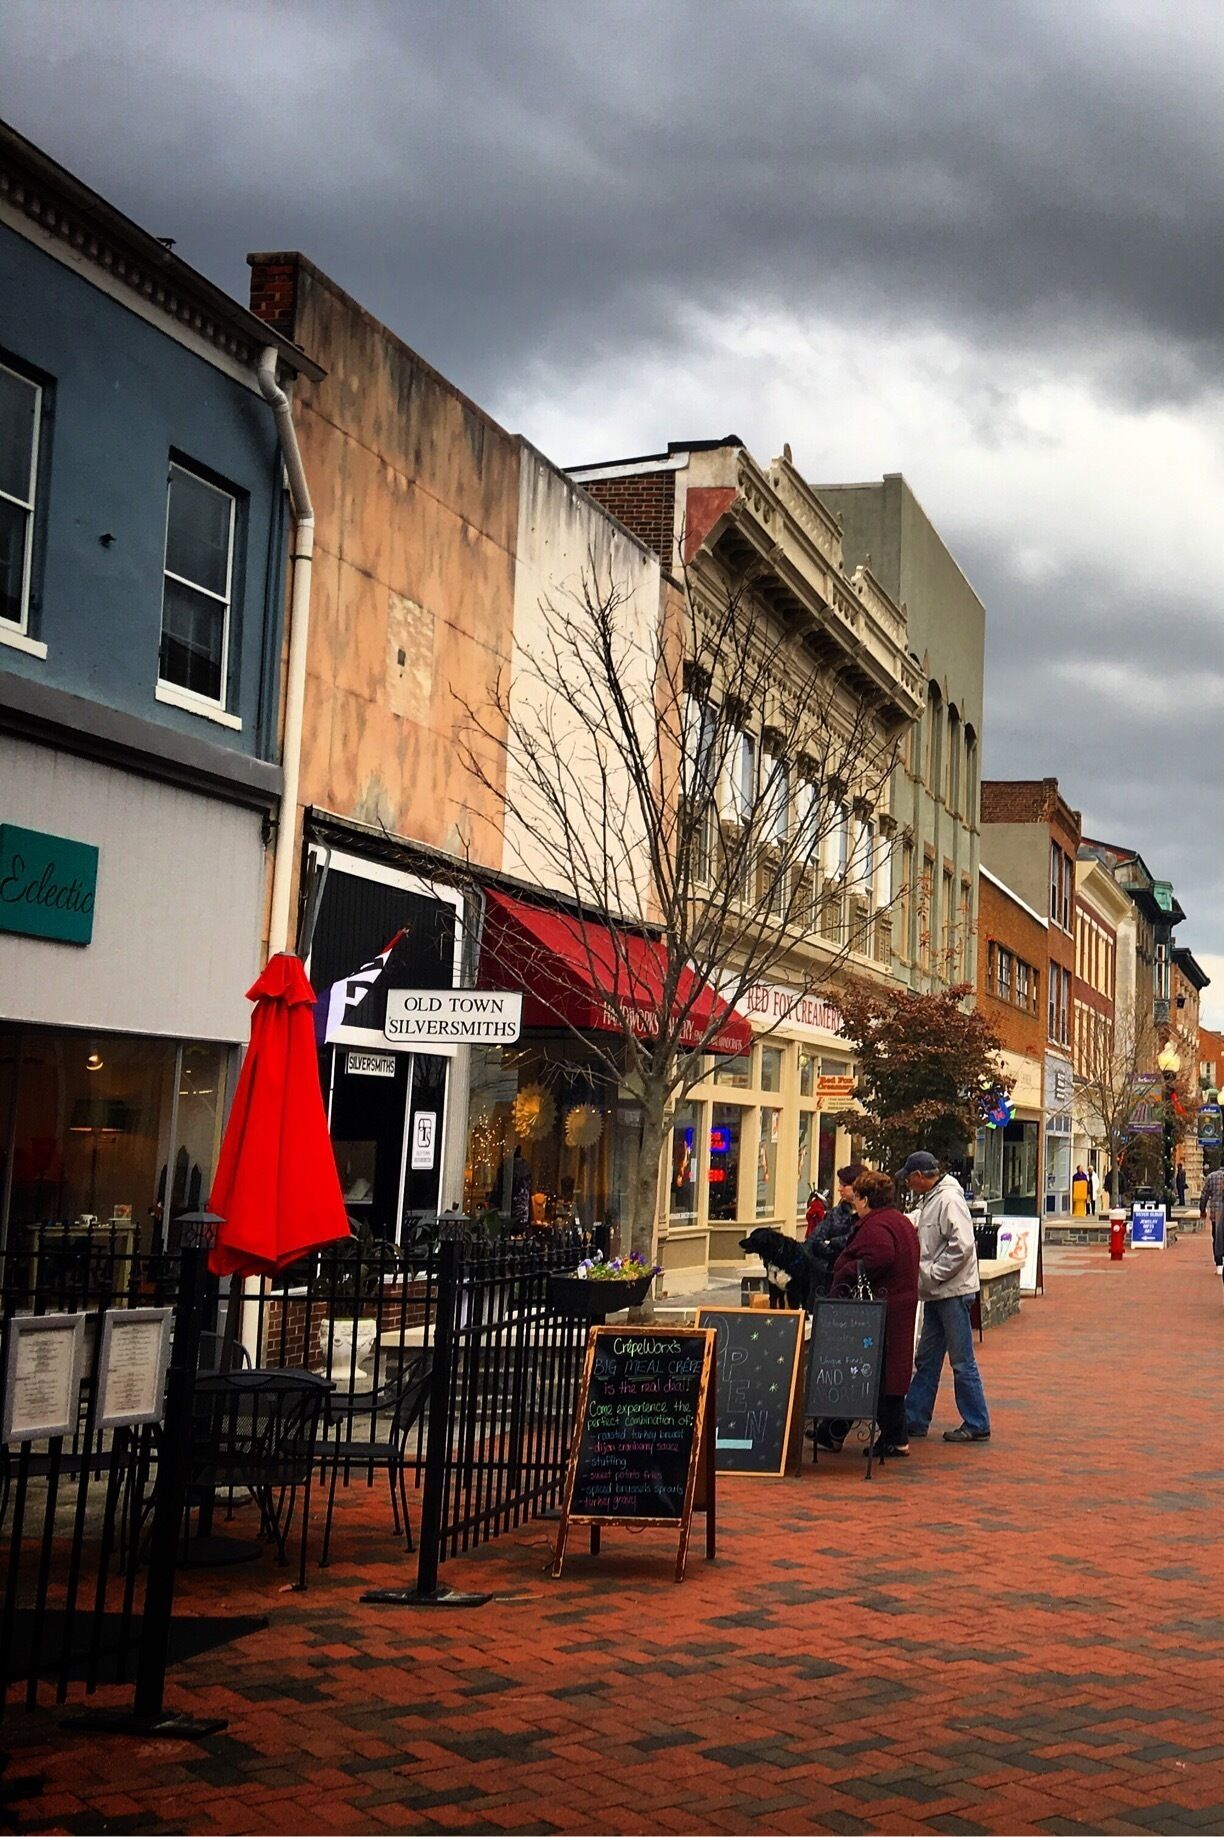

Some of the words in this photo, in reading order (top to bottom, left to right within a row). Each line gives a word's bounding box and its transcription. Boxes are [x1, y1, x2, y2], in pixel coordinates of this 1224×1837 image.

[404, 997, 442, 1012] OLD
[449, 998, 504, 1013] TOWN
[747, 986, 769, 1013] RED
[773, 992, 793, 1020] FOX
[389, 1019, 516, 1036] SILVERSMITHS
[349, 1055, 396, 1073] SILVERSMITHS
[594, 1359, 617, 1376] BIG
[624, 1359, 664, 1375] MEAL
[816, 1369, 843, 1386] AND
[604, 1382, 615, 1395] is
[619, 1379, 637, 1394] the
[641, 1378, 660, 1393] real
[589, 1400, 613, 1417] Come
[616, 1401, 668, 1416] experience
[674, 1401, 692, 1412] the
[587, 1416, 619, 1430] perfect
[624, 1414, 675, 1426] combination
